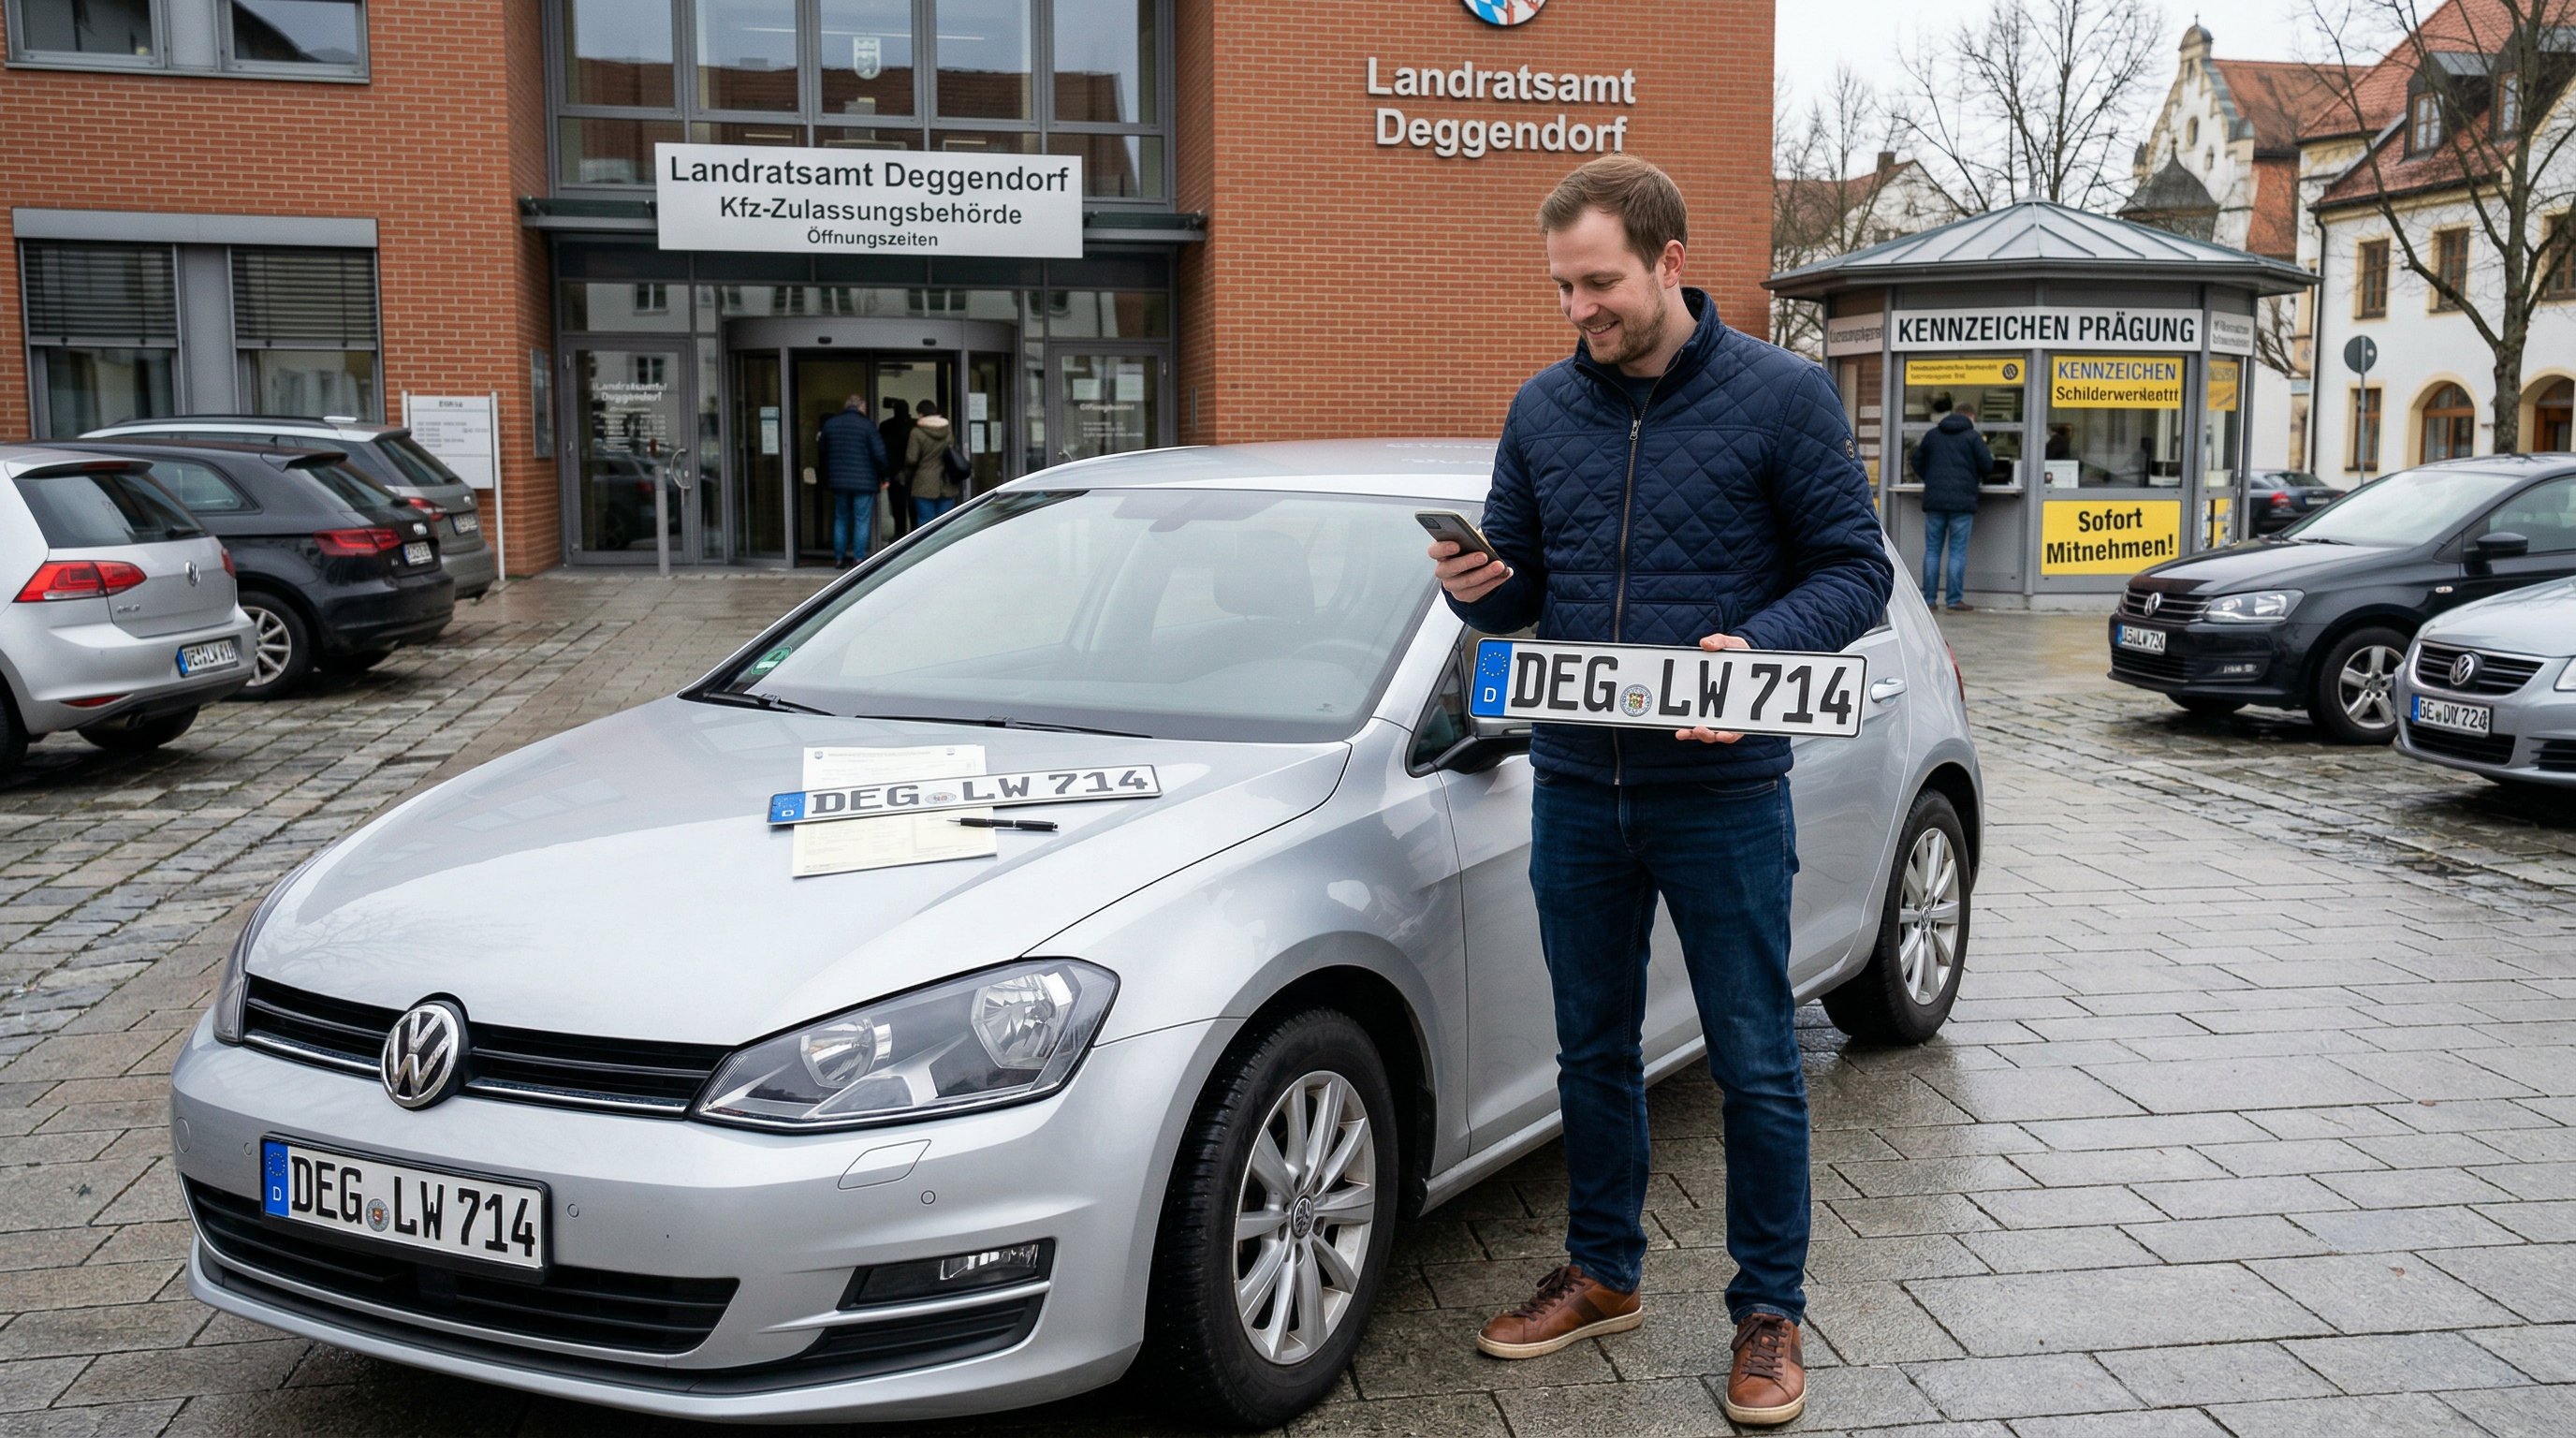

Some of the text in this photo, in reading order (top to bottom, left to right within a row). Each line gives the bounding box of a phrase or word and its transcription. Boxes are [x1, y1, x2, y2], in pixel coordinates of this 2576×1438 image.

[1368, 56, 1636, 105] Landratsamt
[1376, 108, 1628, 158] Deggendorf
[670, 155, 1069, 196] Landratsamt Deggendorf
[720, 196, 1022, 227] Kfz-Zulassungsbehörde
[807, 226, 938, 248] Öffnungszeiten
[1898, 315, 2070, 343] KENNZEICHEN
[2079, 311, 2195, 343] PRÄGUNG
[2057, 361, 2176, 380] KENNZEICHEN
[2078, 507, 2143, 533] Sofort
[2046, 534, 2174, 565] Mitnehmen!
[1483, 687, 1497, 703] D
[1511, 652, 1619, 713] DEG
[1658, 658, 1734, 719] LW
[1749, 663, 1852, 726] 714
[812, 770, 1149, 814] DEG LW 714
[781, 809, 795, 818] D
[272, 1186, 282, 1201] D
[291, 1154, 535, 1257] DEG LW 714
